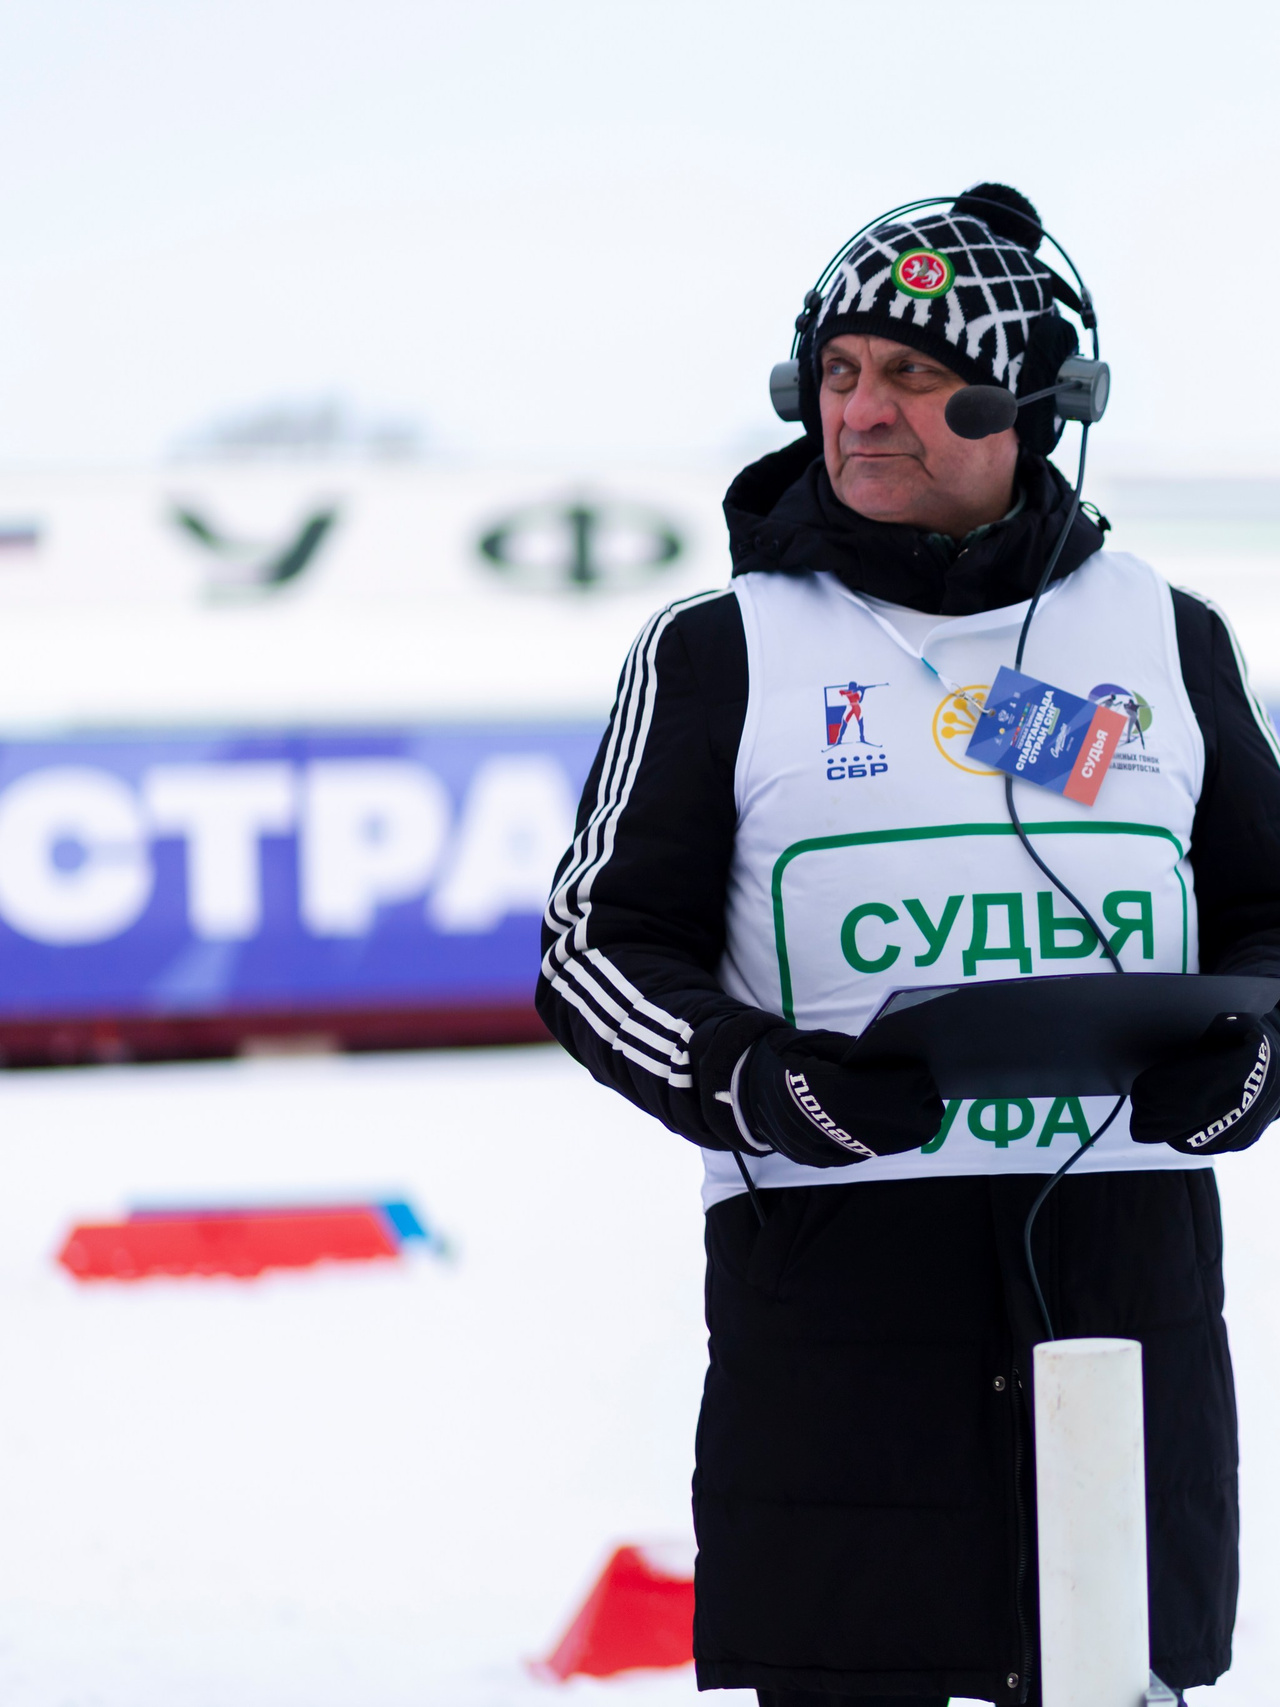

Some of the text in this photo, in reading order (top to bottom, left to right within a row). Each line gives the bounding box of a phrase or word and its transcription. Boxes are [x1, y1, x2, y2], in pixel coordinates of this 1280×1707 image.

[1015, 690, 1054, 771] СПАРТАКИАДА
[1028, 726, 1049, 764] СТРАН
[1043, 702, 1058, 726] СНГ
[1081, 729, 1109, 778] СУДЬЯ
[826, 762, 888, 781] СБР
[840, 889, 1154, 977] СУДЬЯ
